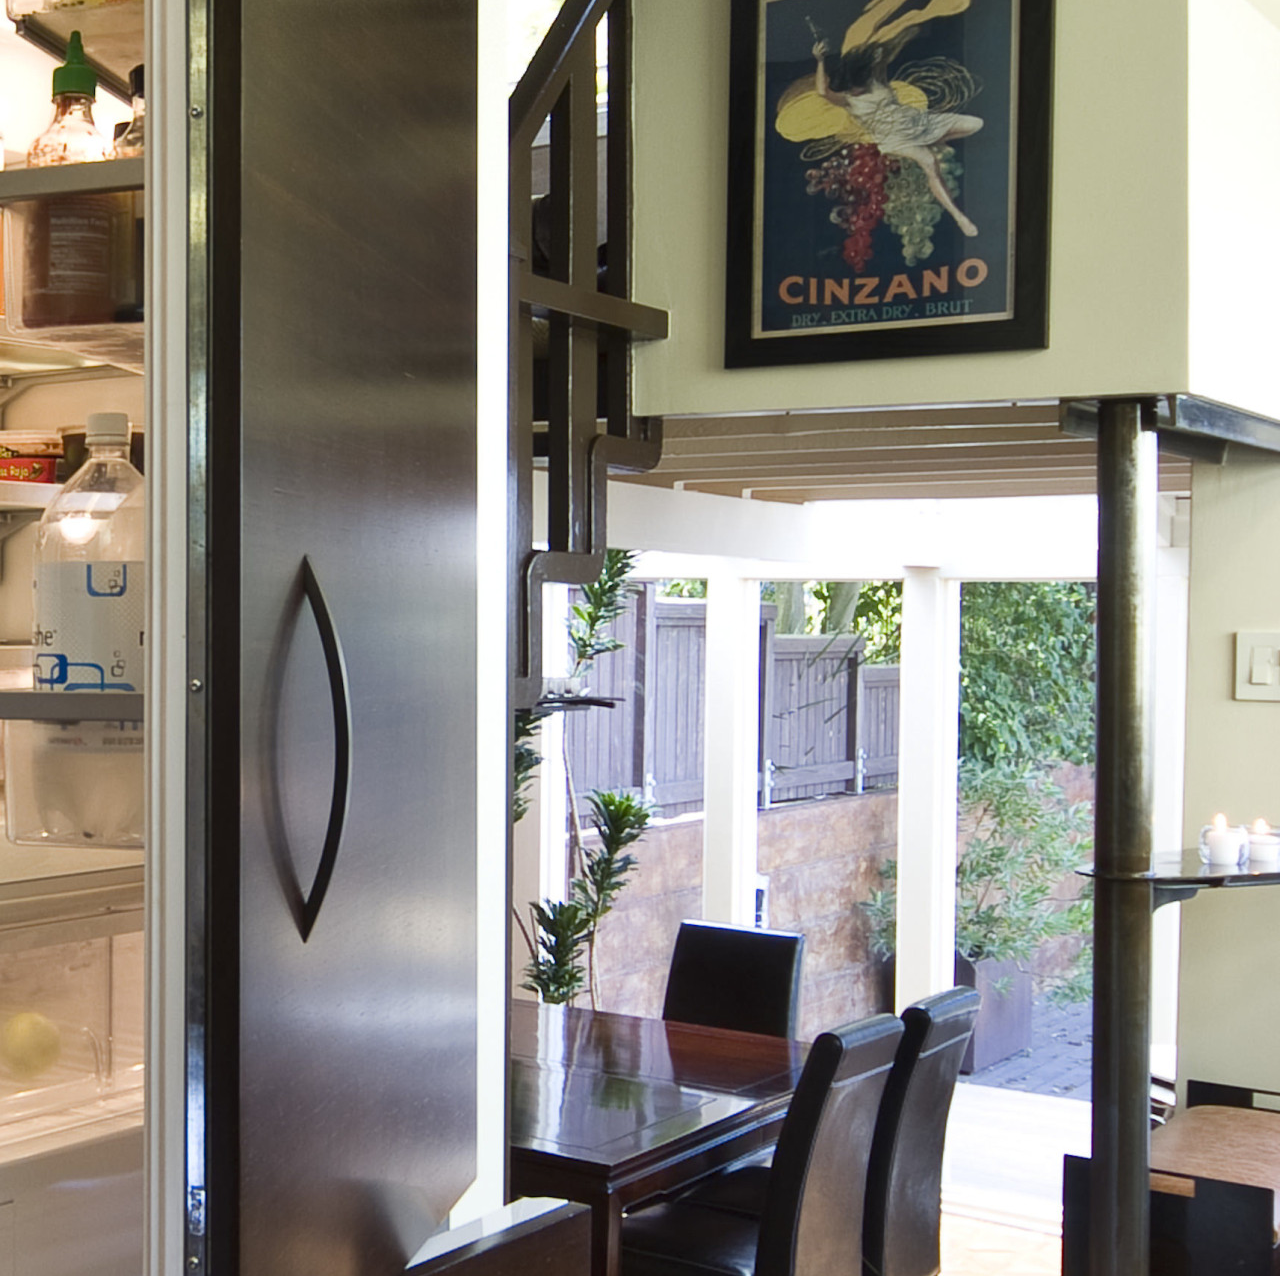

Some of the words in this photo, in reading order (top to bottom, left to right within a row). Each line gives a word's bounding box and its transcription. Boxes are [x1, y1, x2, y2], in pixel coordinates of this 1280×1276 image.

[778, 258, 989, 305] CINZANO
[830, 308, 878, 324] EXTRA
[925, 299, 974, 316] BRUT
